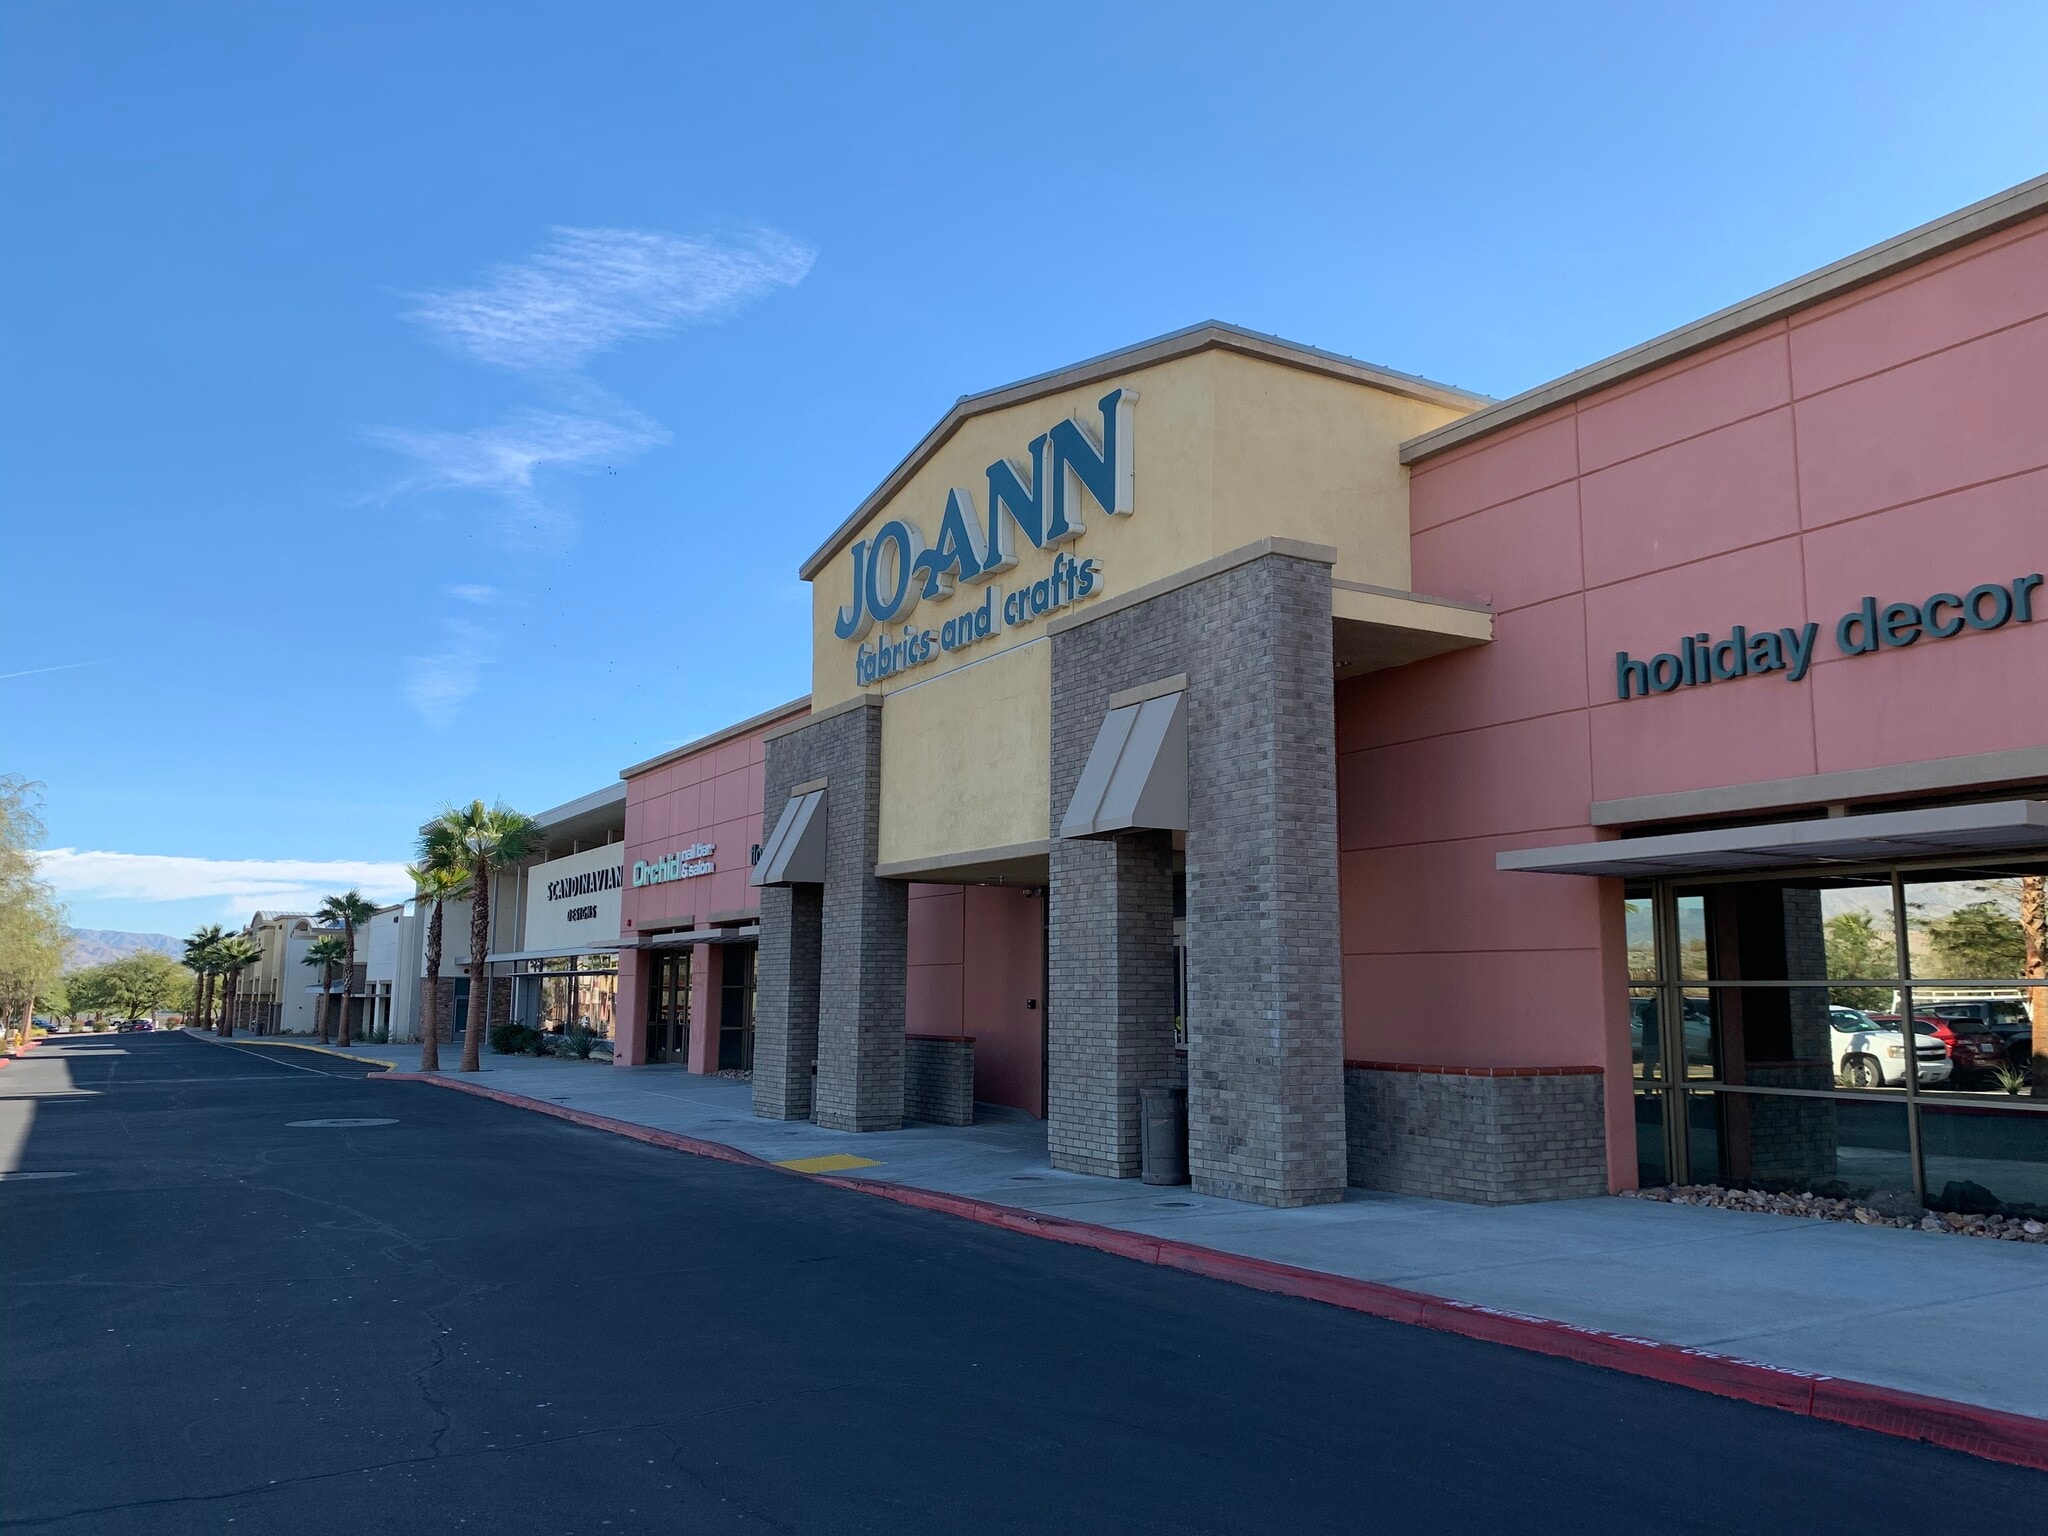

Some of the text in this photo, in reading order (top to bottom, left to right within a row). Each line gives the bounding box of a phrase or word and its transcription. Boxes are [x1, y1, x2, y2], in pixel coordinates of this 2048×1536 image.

[856, 552, 1104, 687] fabrics and crafts
[1615, 573, 2044, 700] holiday decor
[547, 865, 623, 901] SCANDINAVIAN
[632, 851, 681, 887] Orchid
[689, 860, 715, 877] salon
[567, 905, 597, 921] DESIGNS
